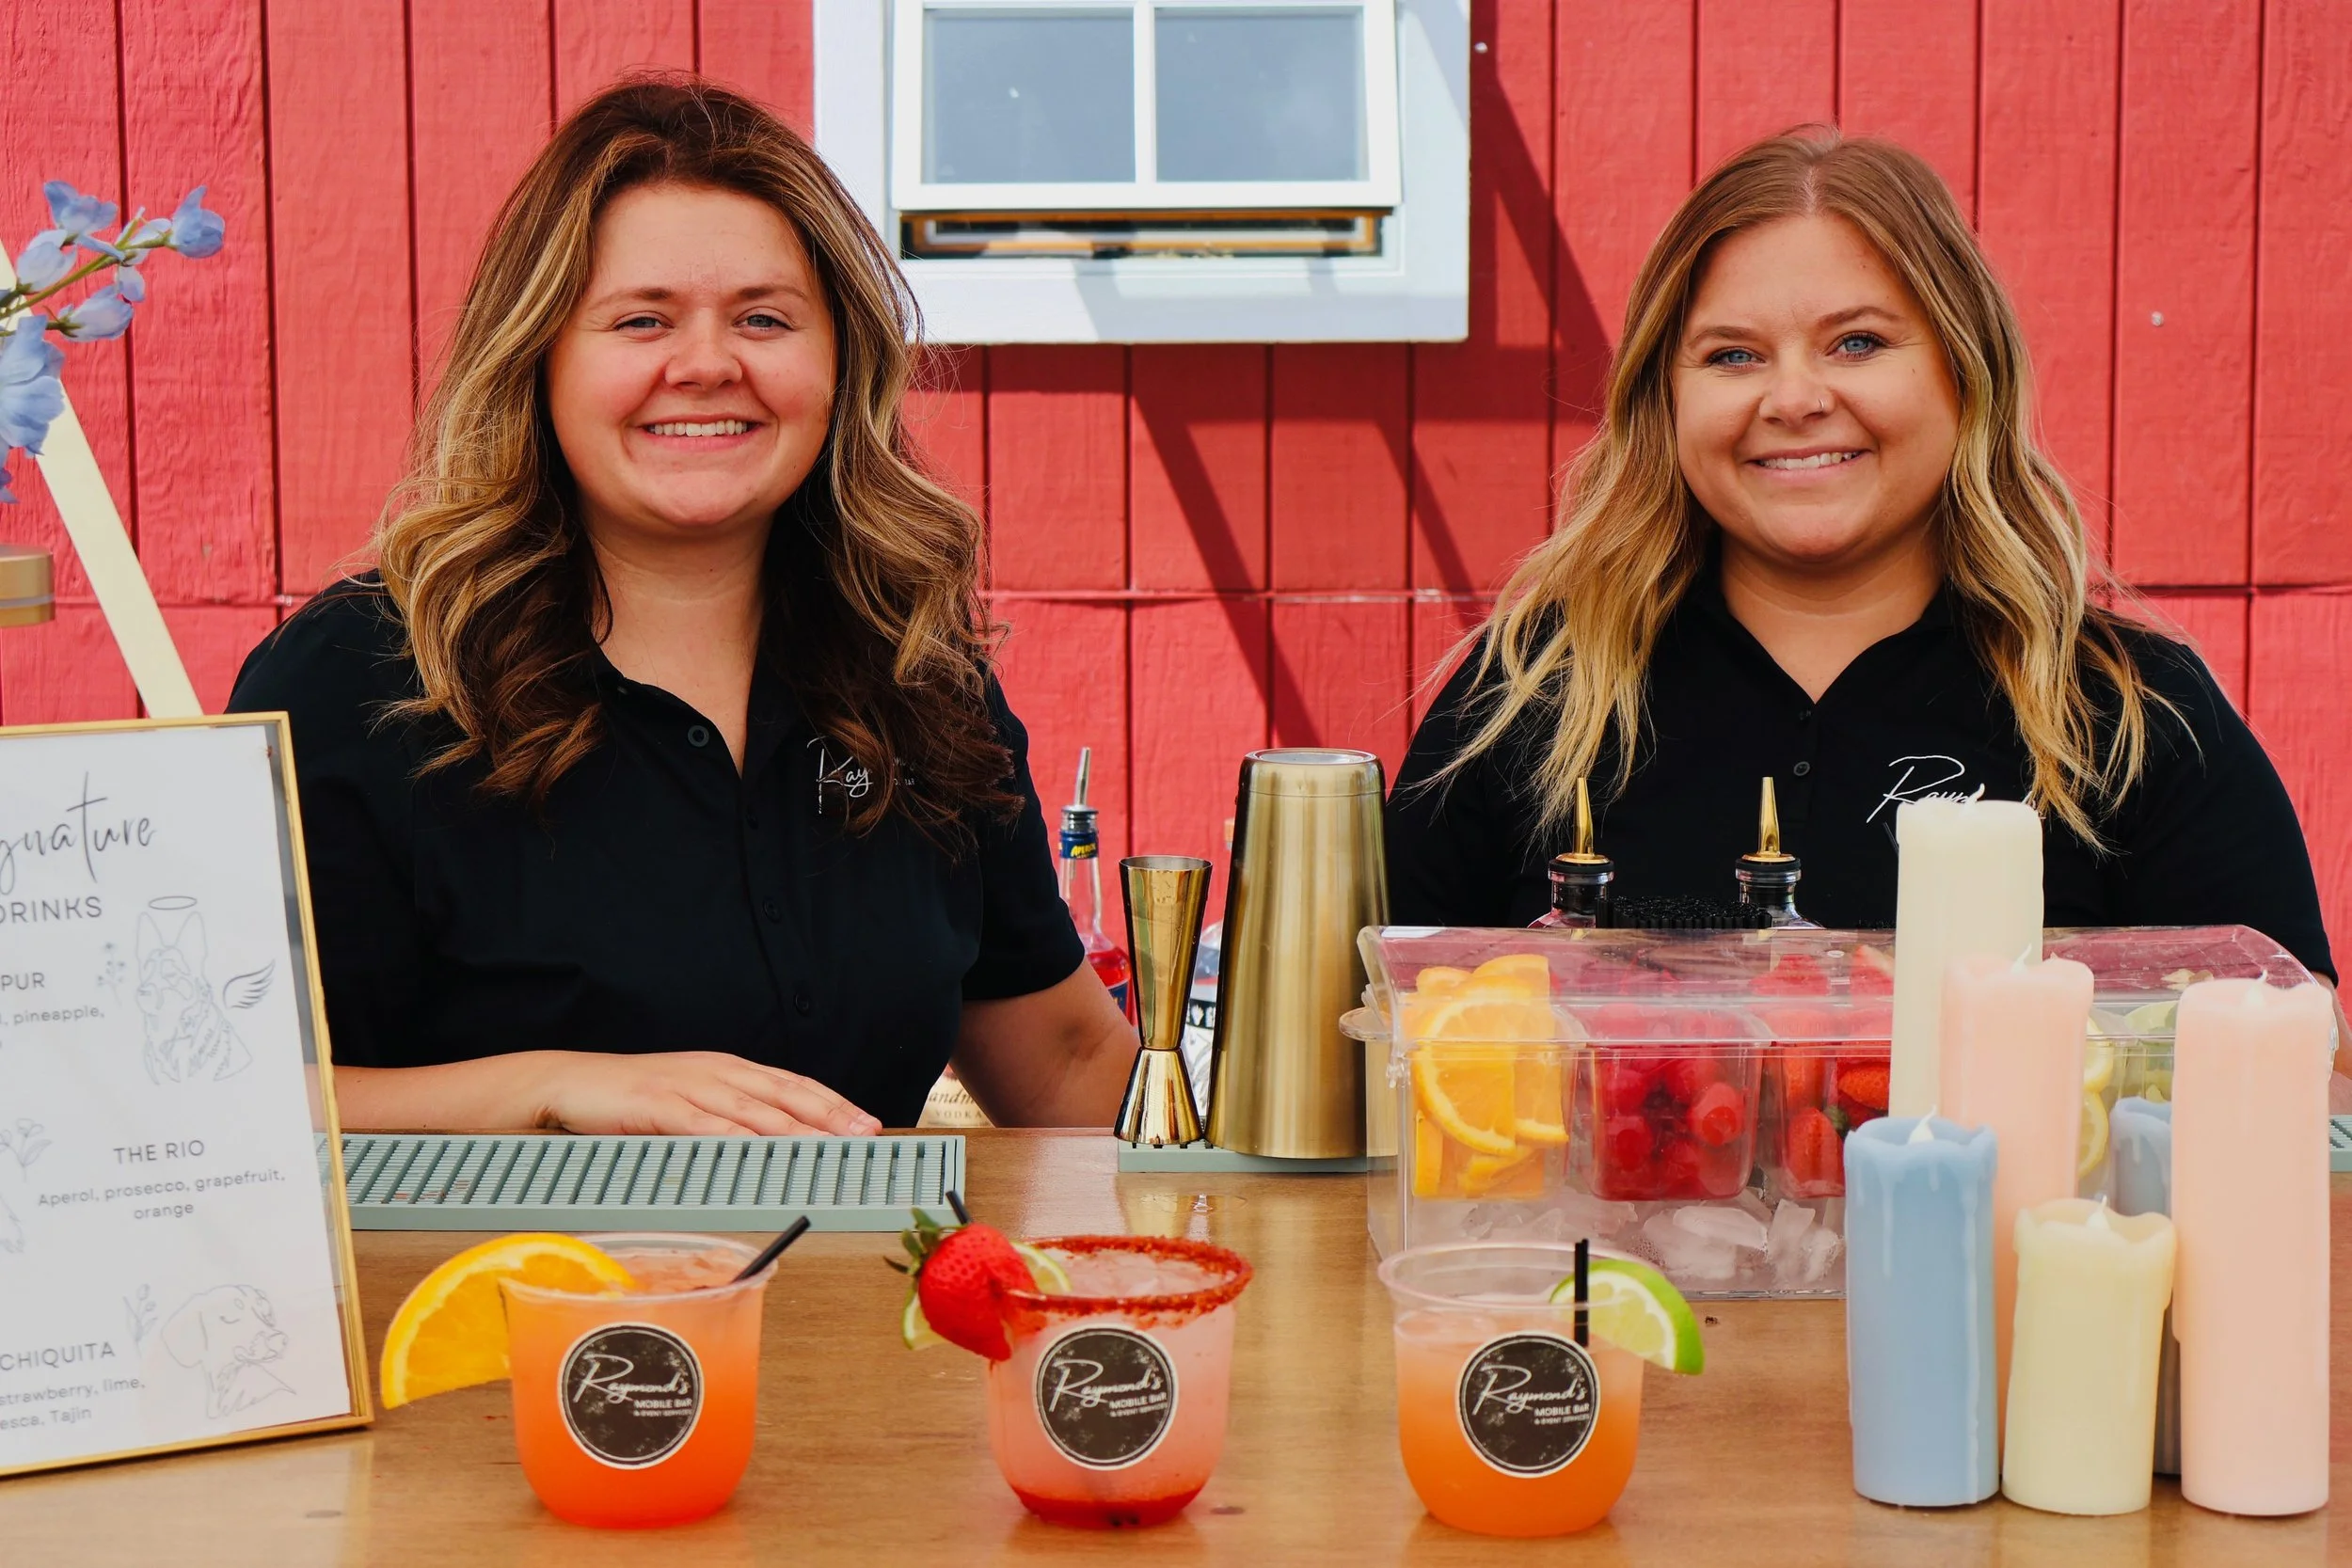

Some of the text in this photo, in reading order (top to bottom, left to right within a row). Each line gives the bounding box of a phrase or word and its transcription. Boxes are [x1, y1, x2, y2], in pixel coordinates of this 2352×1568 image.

[0, 972, 45, 990] PUR
[13, 1005, 105, 1027] pineapple,
[935, 1110, 983, 1119] VODKA
[113, 1139, 206, 1165] THE RIO
[38, 1168, 286, 1209] Aperol, prosecco, grapefruit,
[134, 1202, 195, 1221] orange
[0, 1341, 116, 1371] CHIQUITA
[572, 1353, 691, 1404] Raymond's
[1048, 1358, 1165, 1413] Raymond's
[1471, 1364, 1588, 1416] Raymond's
[0, 1377, 146, 1406] strawberry, lime,
[1109, 1396, 1148, 1409] MOBILE
[633, 1399, 673, 1409] MOBILE
[1534, 1405, 1572, 1417] MOBILE
